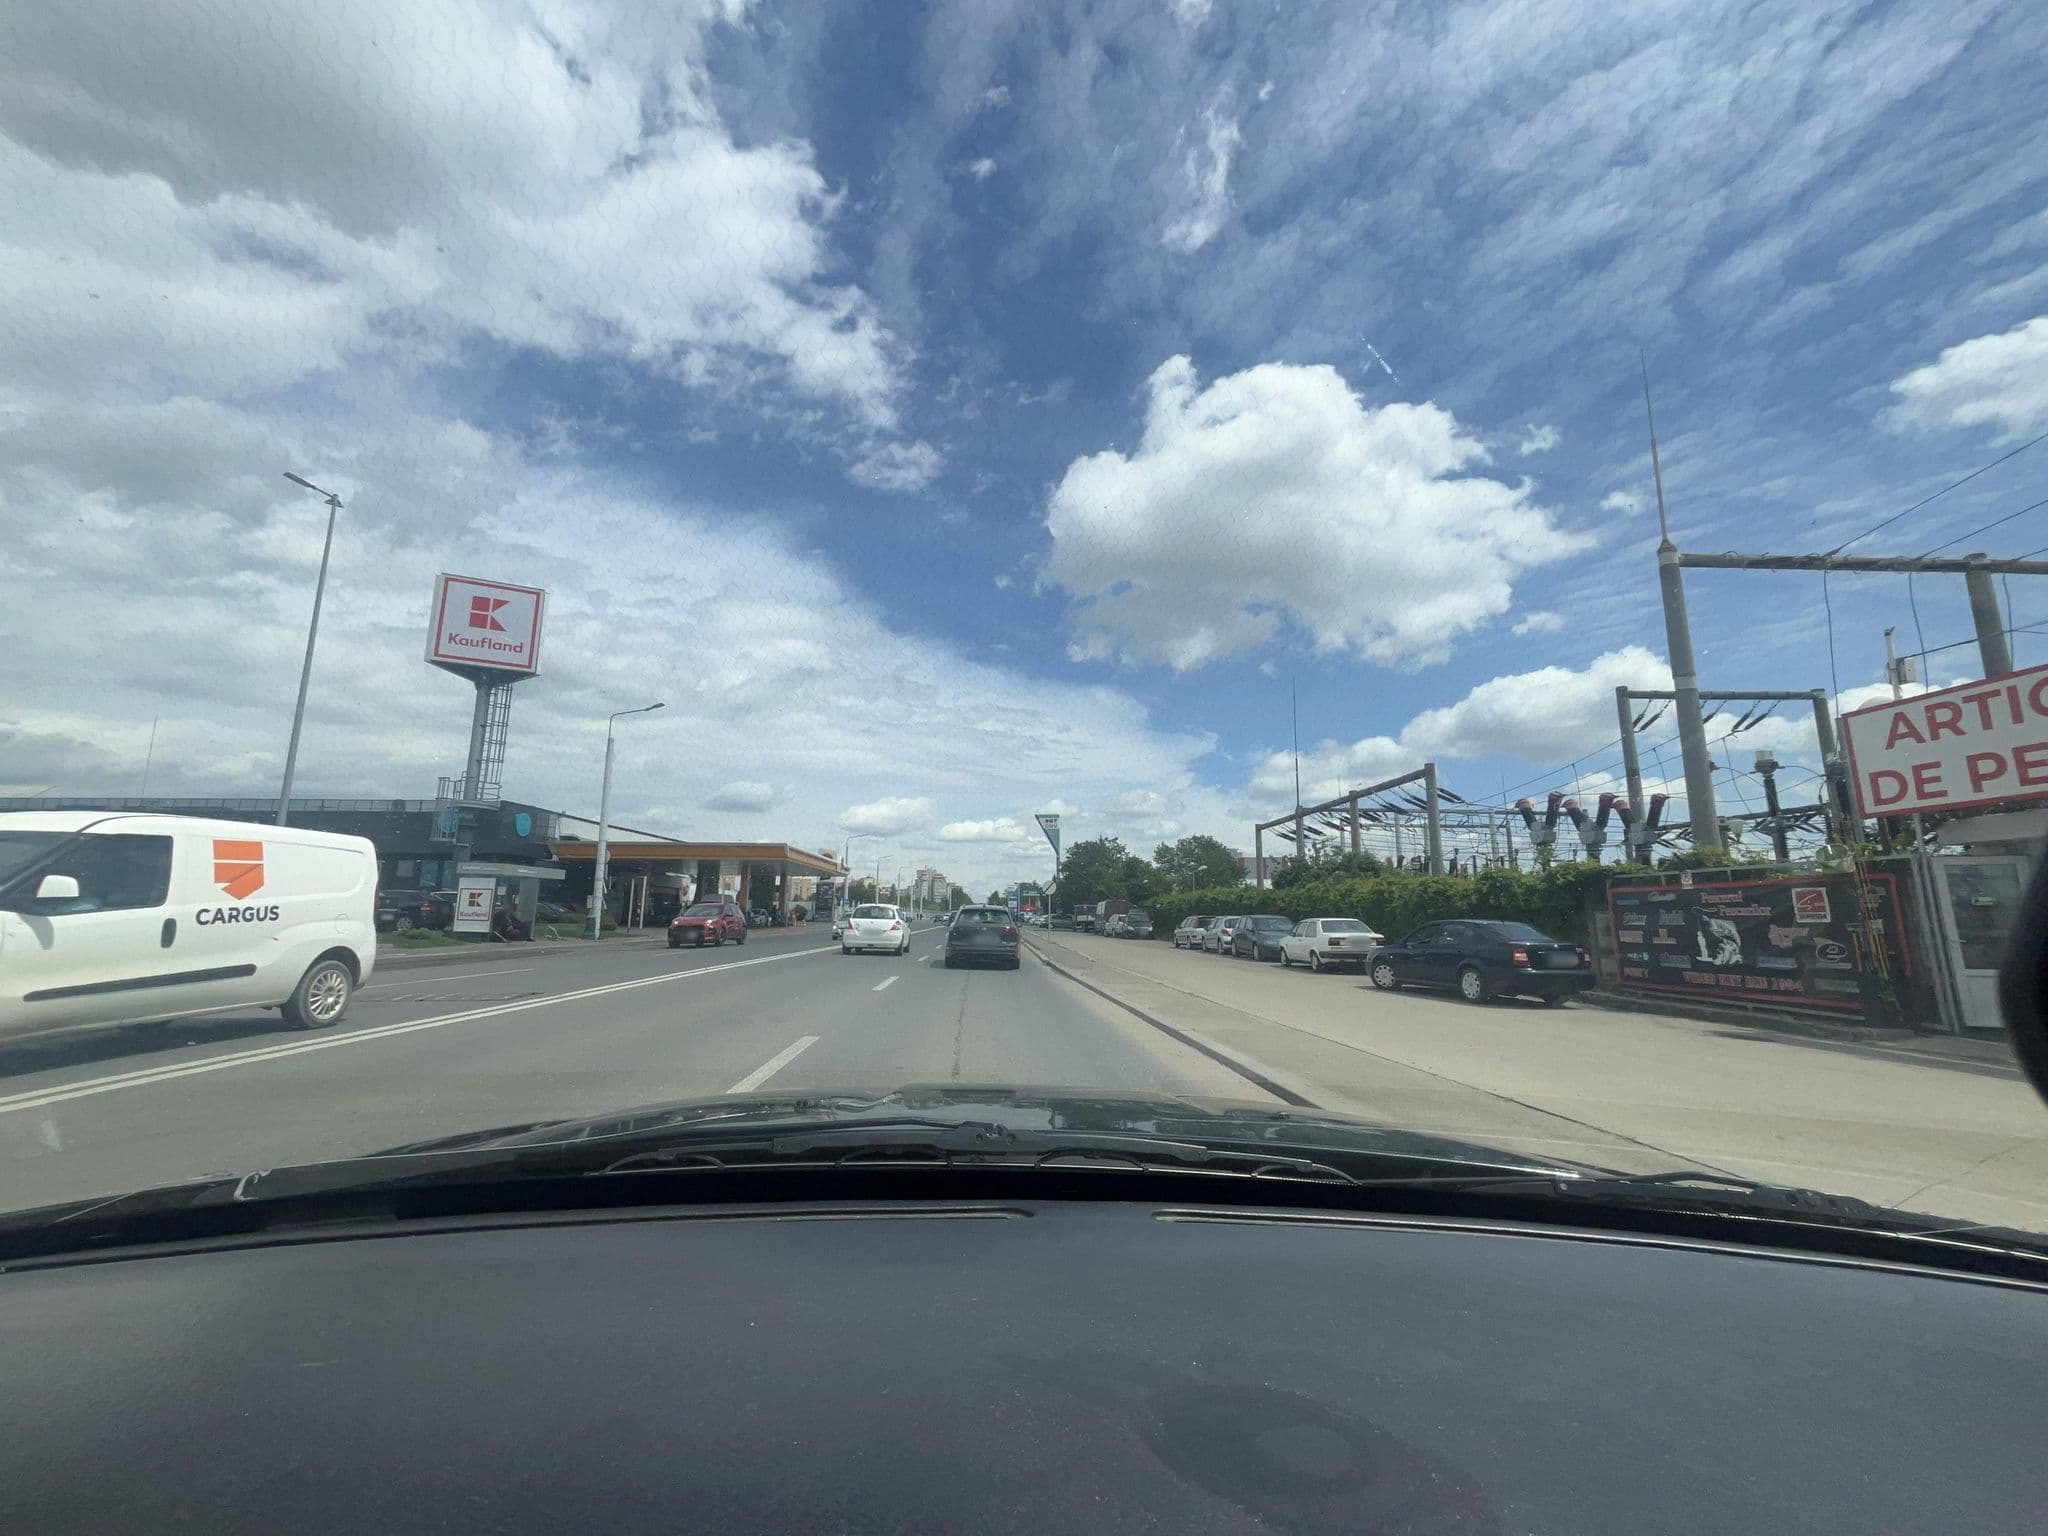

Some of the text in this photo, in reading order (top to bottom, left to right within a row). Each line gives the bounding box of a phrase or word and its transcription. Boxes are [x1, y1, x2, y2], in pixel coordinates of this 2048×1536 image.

[448, 633, 523, 653] Kaufland
[1869, 761, 1948, 807] DE
[1966, 742, 2048, 794] PE
[196, 905, 280, 926] CARGUS
